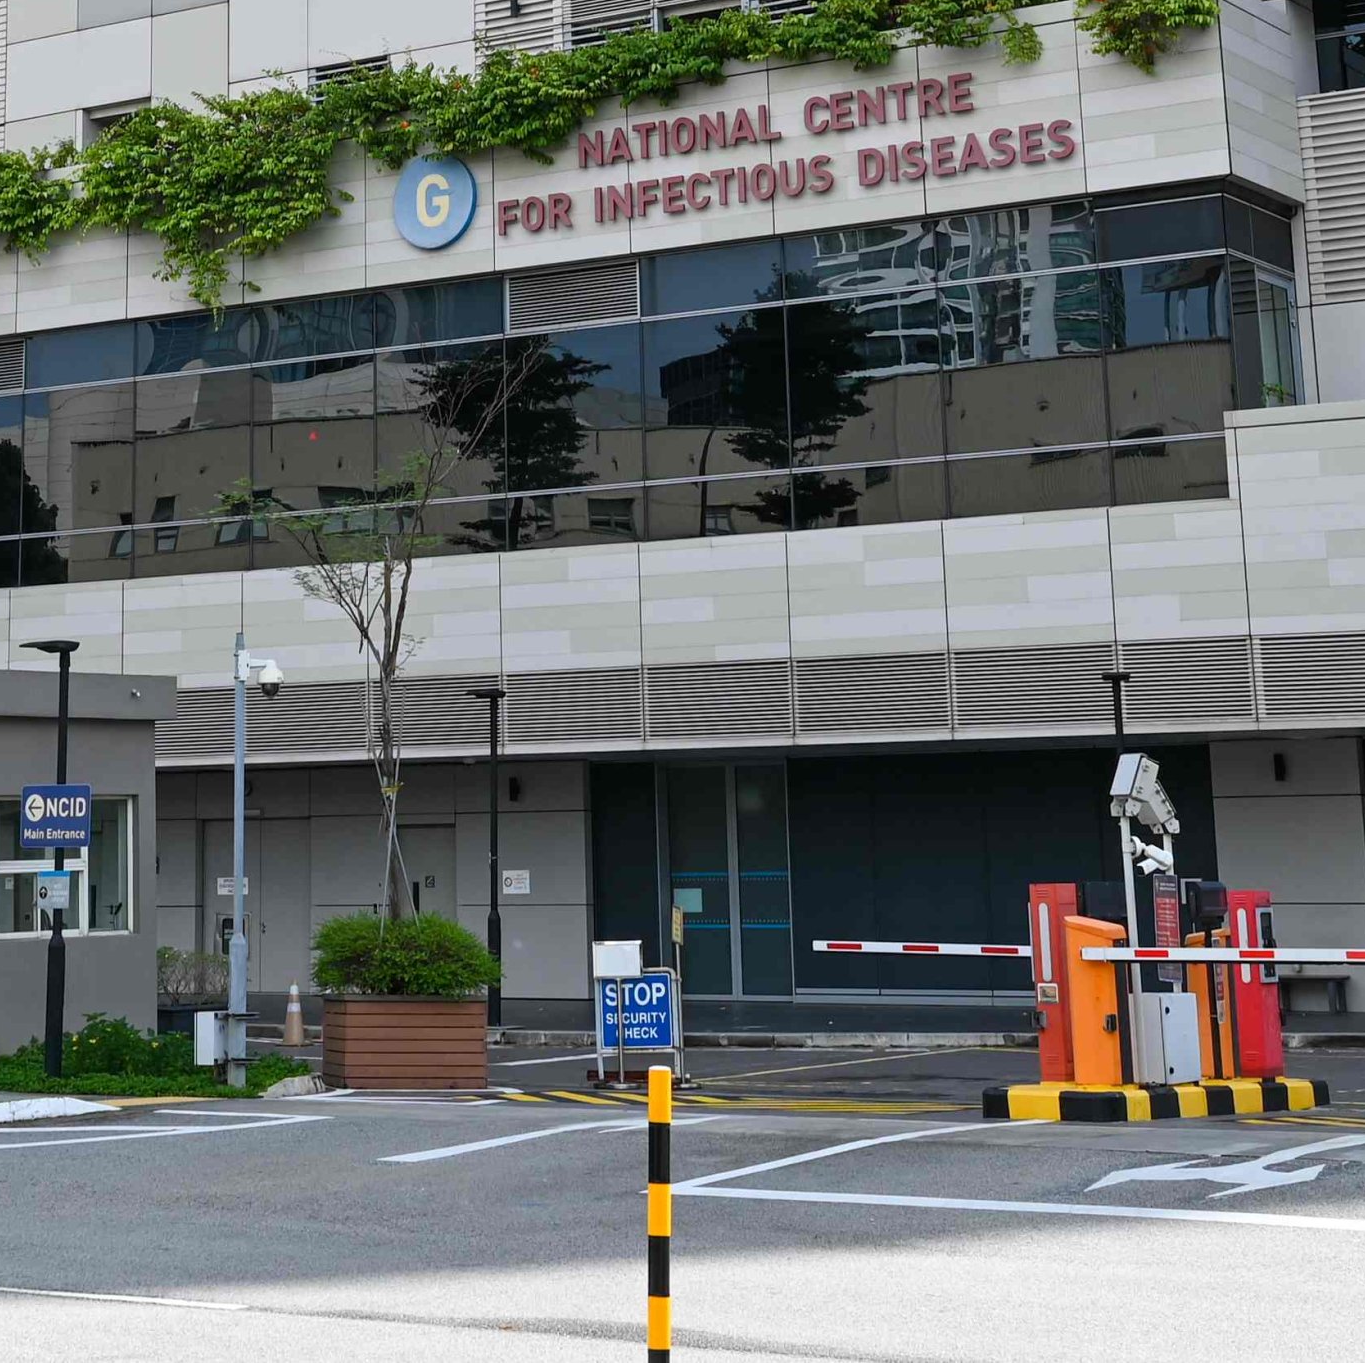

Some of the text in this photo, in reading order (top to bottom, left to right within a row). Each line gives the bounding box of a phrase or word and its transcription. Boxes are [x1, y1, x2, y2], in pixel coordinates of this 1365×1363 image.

[578, 72, 975, 168] NATIONAL CENTRE
[498, 119, 1075, 237] FOR INFECTIOUS DISEASES
[416, 174, 450, 228] G
[46, 797, 86, 817] NCID
[24, 828, 85, 839] Main Entrance
[605, 982, 666, 1006] STOP
[616, 1026, 658, 1039] HECK
